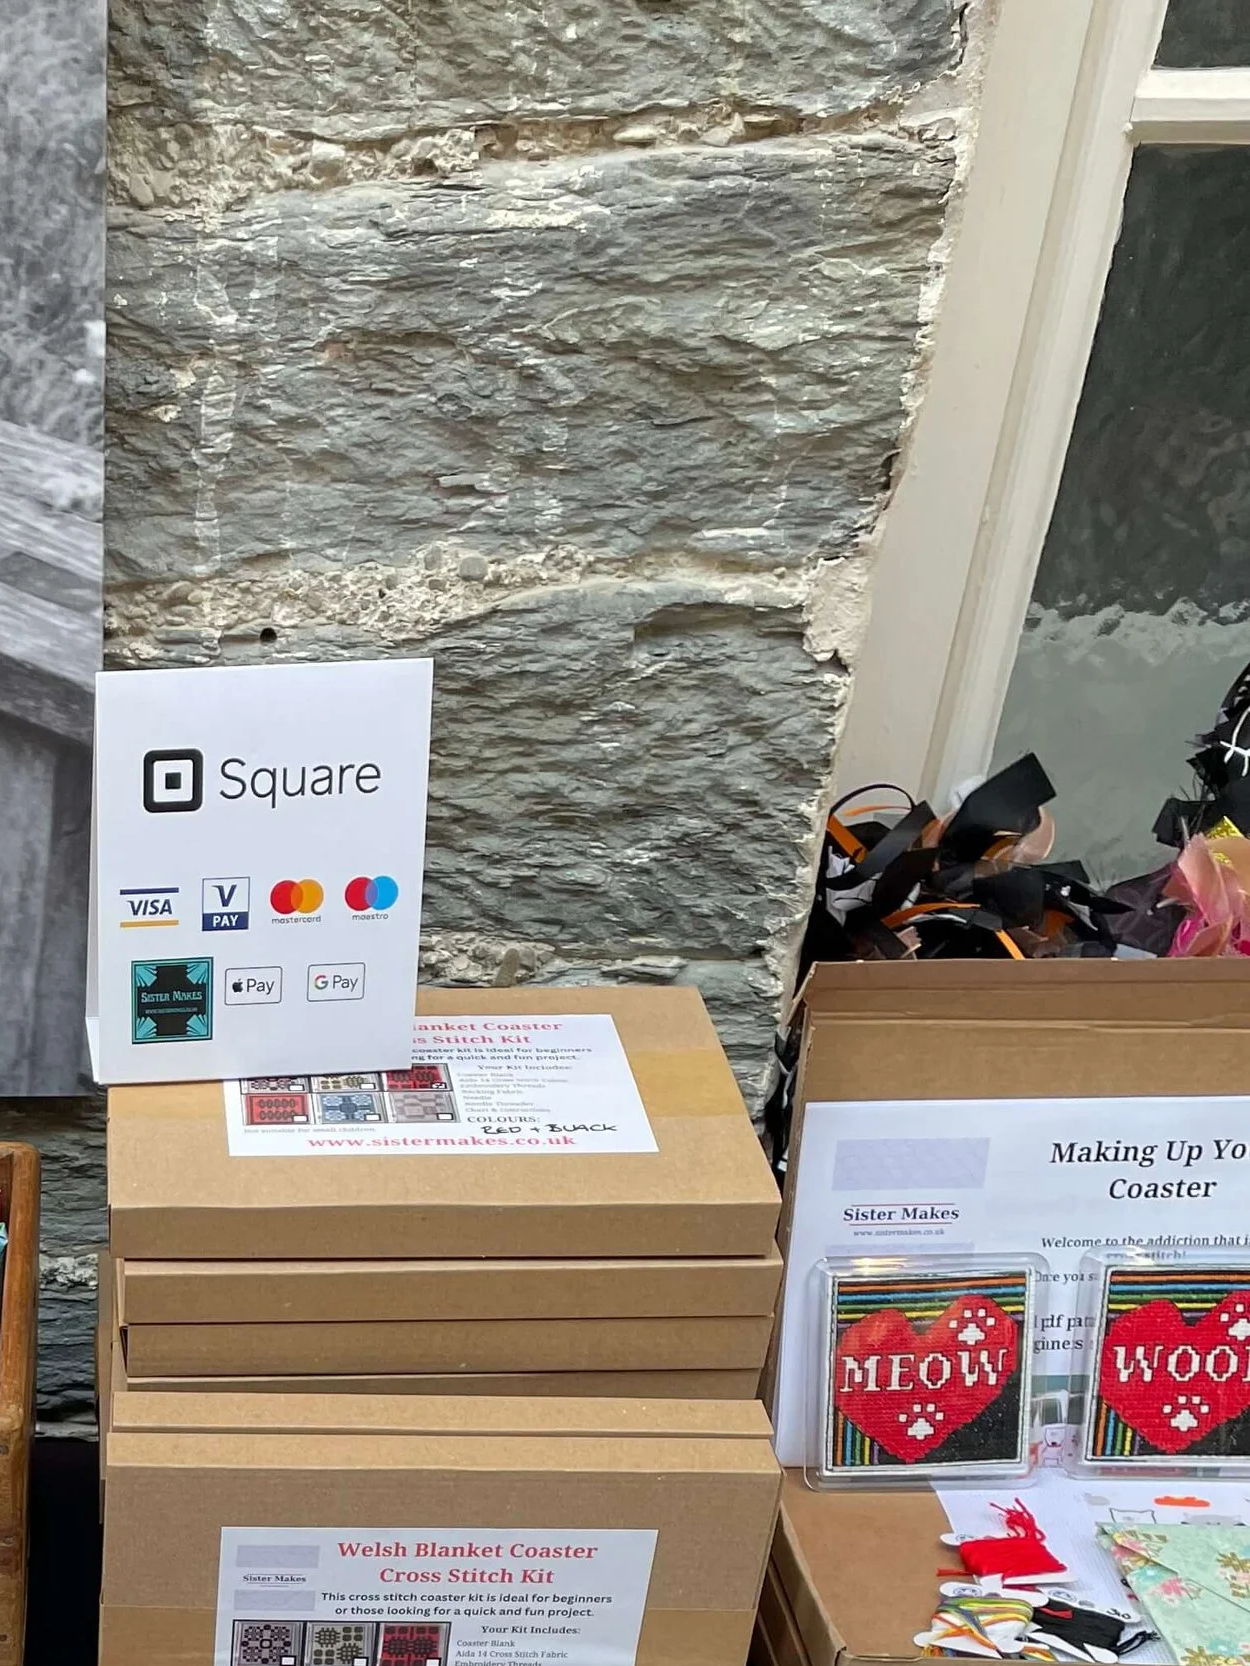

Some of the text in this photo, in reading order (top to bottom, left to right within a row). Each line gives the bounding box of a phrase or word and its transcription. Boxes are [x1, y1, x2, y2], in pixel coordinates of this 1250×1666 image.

[219, 758, 381, 809] Square
[214, 884, 237, 907] V
[127, 899, 173, 916] VISA
[212, 915, 238, 927] PAY
[272, 915, 321, 924] mastercard
[352, 912, 389, 921] maestro
[246, 978, 275, 995] Pay
[314, 975, 358, 992] G Pay
[141, 990, 202, 1004] SISTER MAKES
[413, 1022, 562, 1031] anket Coaster
[433, 1035, 531, 1044] Stitch Kit
[481, 1126, 521, 1134] RED
[308, 1135, 577, 1148] www.sistermakes.co.uk
[1050, 1140, 1250, 1167] Making Up Yo
[1110, 1178, 1217, 1199] Coaster
[843, 1206, 960, 1222] Sister Makes
[1041, 1234, 1240, 1249] Welcome to the addiction that
[840, 1347, 1008, 1393] MEOW
[338, 1542, 598, 1559] Welsh Blanket Coaster
[380, 1568, 554, 1583] Cross Stitch Kit
[322, 1593, 346, 1601] This
[383, 1593, 417, 1602] stitch
[420, 1594, 466, 1602] coaster
[468, 1593, 483, 1602] kit
[487, 1594, 496, 1602] is
[499, 1594, 528, 1602] ideal
[532, 1594, 549, 1603] for
[552, 1594, 612, 1605] beginners
[351, 1607, 383, 1615] those
[387, 1607, 431, 1617] looking
[433, 1607, 450, 1615] for
[464, 1607, 496, 1617] quick
[499, 1607, 521, 1616] and
[525, 1607, 544, 1616] fun
[548, 1608, 594, 1618] project.
[482, 1626, 580, 1634] Your Kit Includes:
